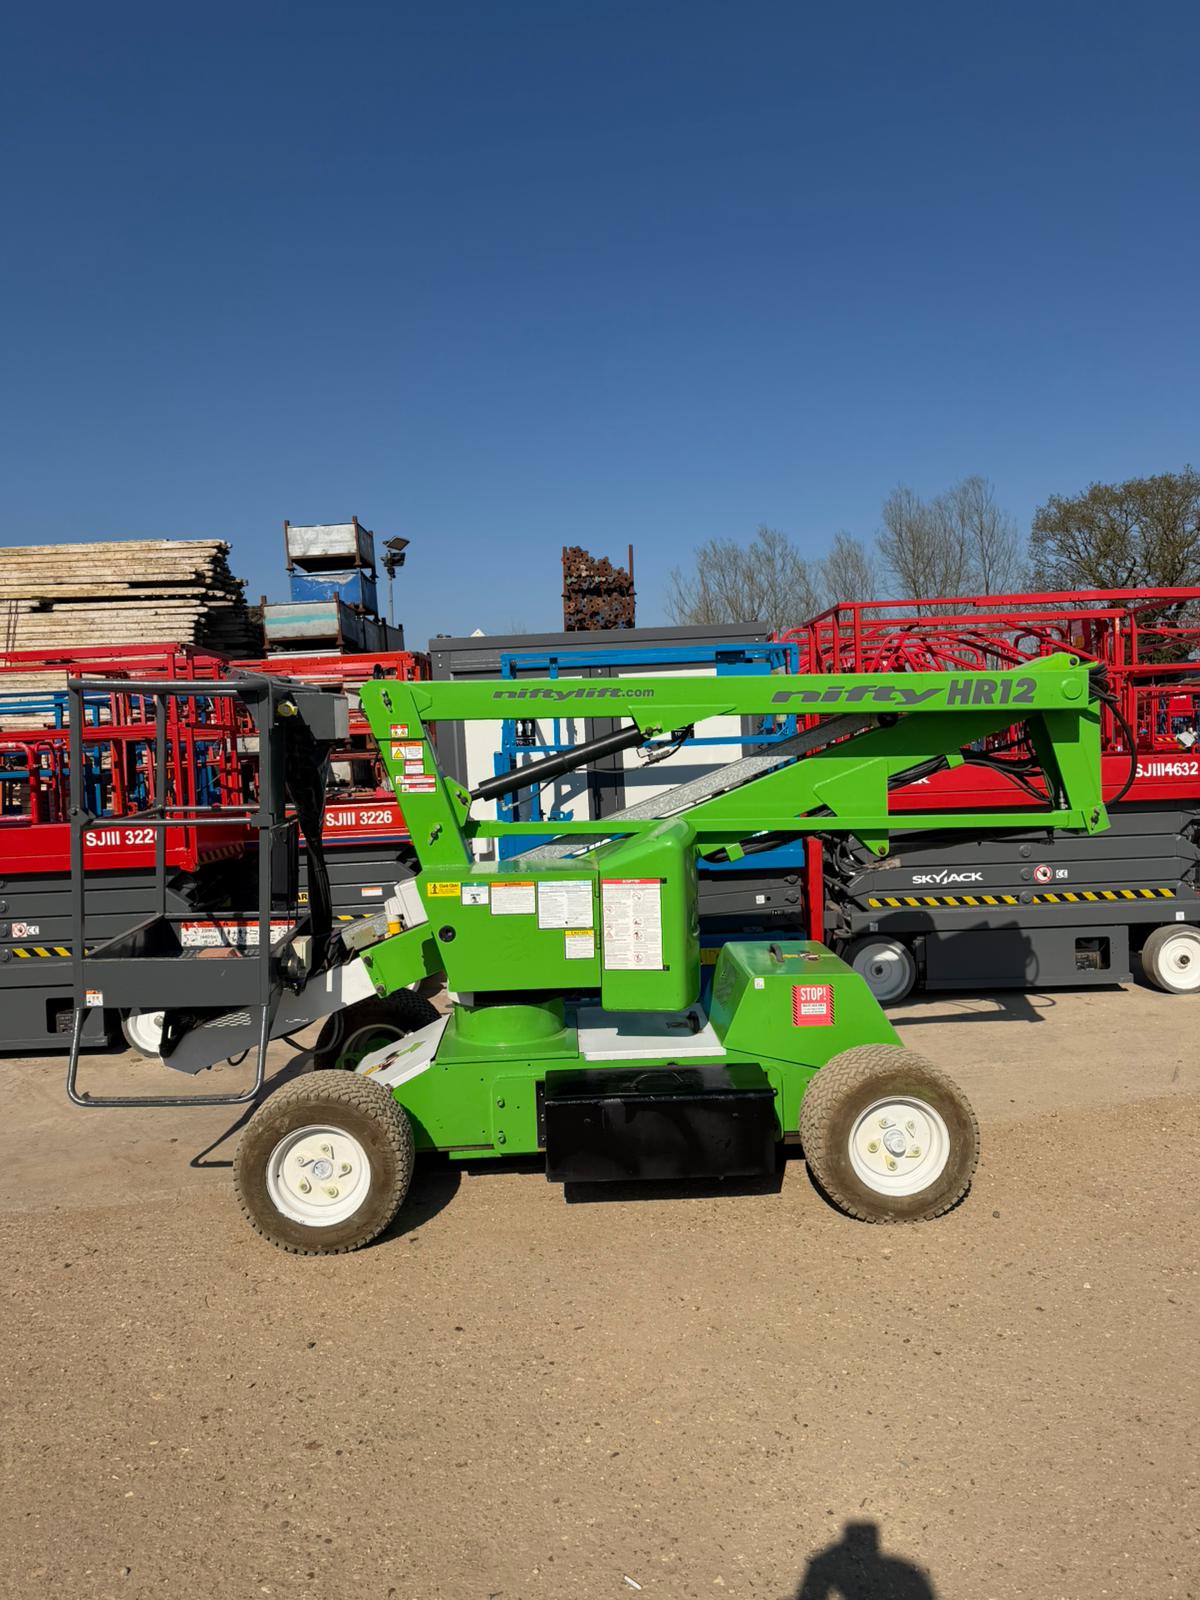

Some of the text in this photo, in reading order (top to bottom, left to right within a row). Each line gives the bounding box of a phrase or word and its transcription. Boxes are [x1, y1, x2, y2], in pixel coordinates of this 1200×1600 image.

[493, 687, 655, 702] niftylift.com
[771, 677, 1037, 706] nifty HR12
[325, 810, 393, 826] SJIII 3226
[86, 828, 158, 847] SJIII 322
[912, 869, 984, 885] SKYJACK
[800, 987, 827, 1001] STOP!
